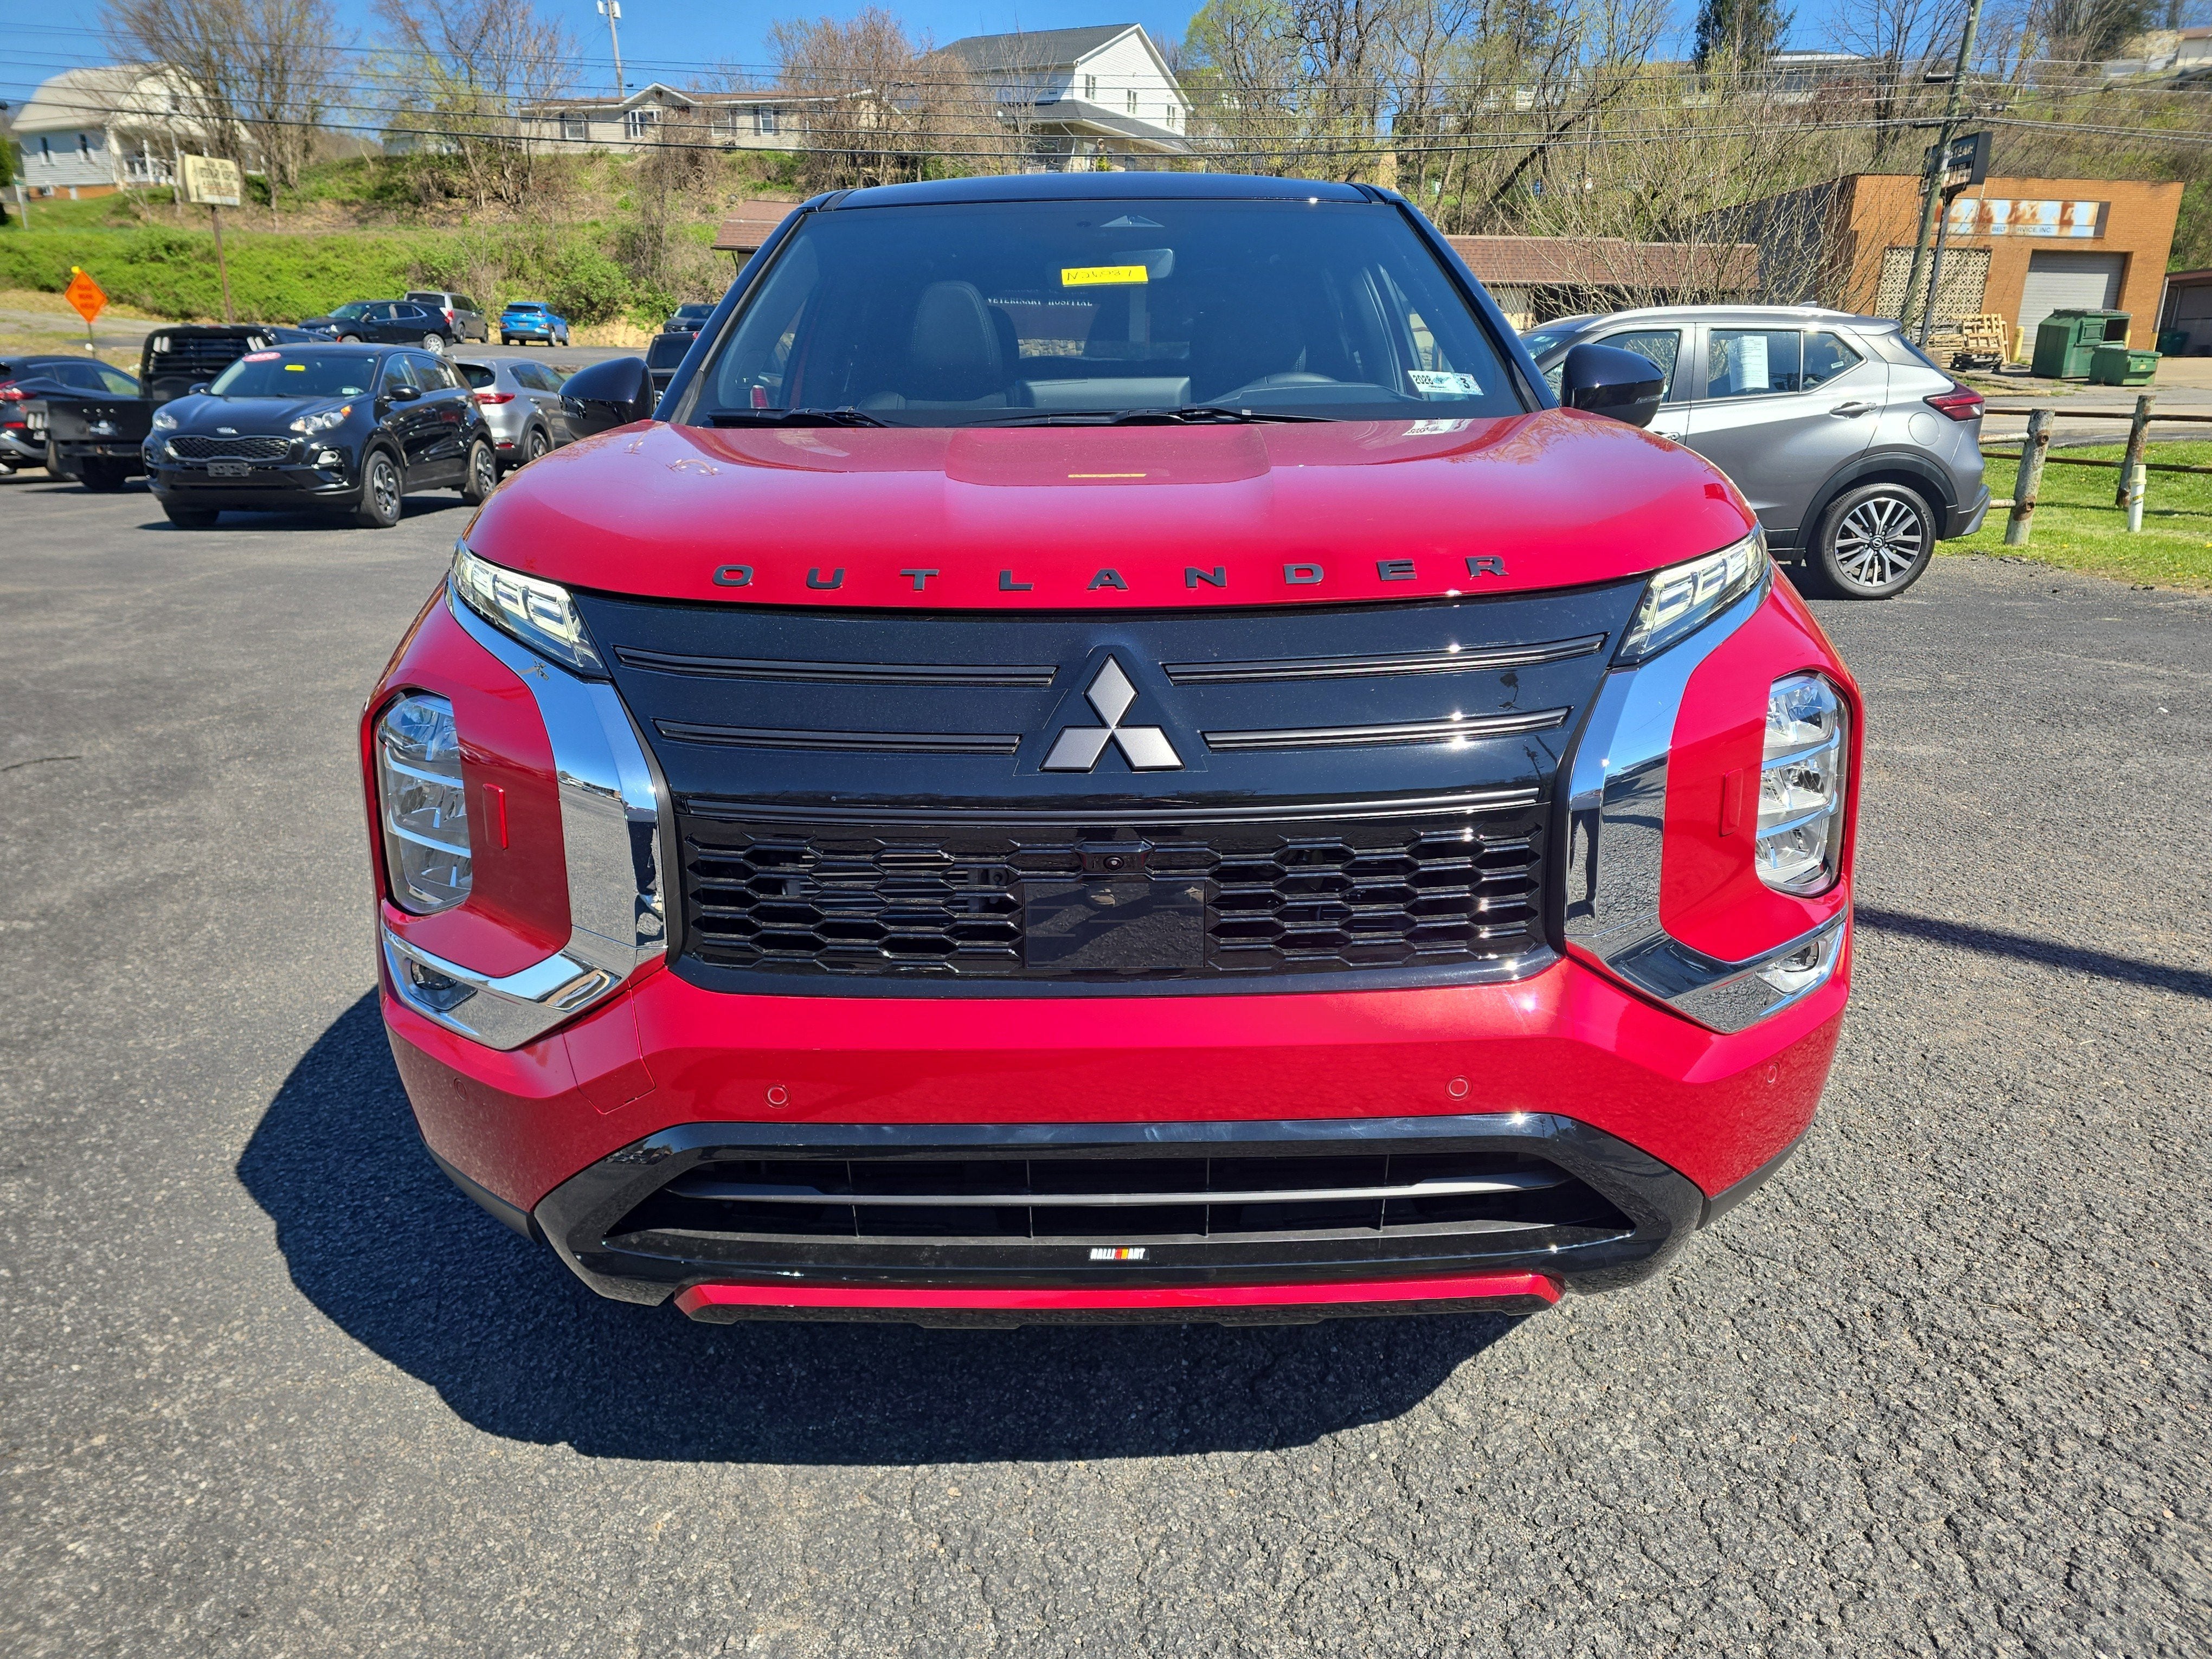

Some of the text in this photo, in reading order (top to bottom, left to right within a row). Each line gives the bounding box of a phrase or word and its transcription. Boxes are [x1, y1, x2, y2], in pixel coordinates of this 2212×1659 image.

[1413, 375, 1470, 389] 2028 3
[712, 556, 1509, 591] OUTLANDER
